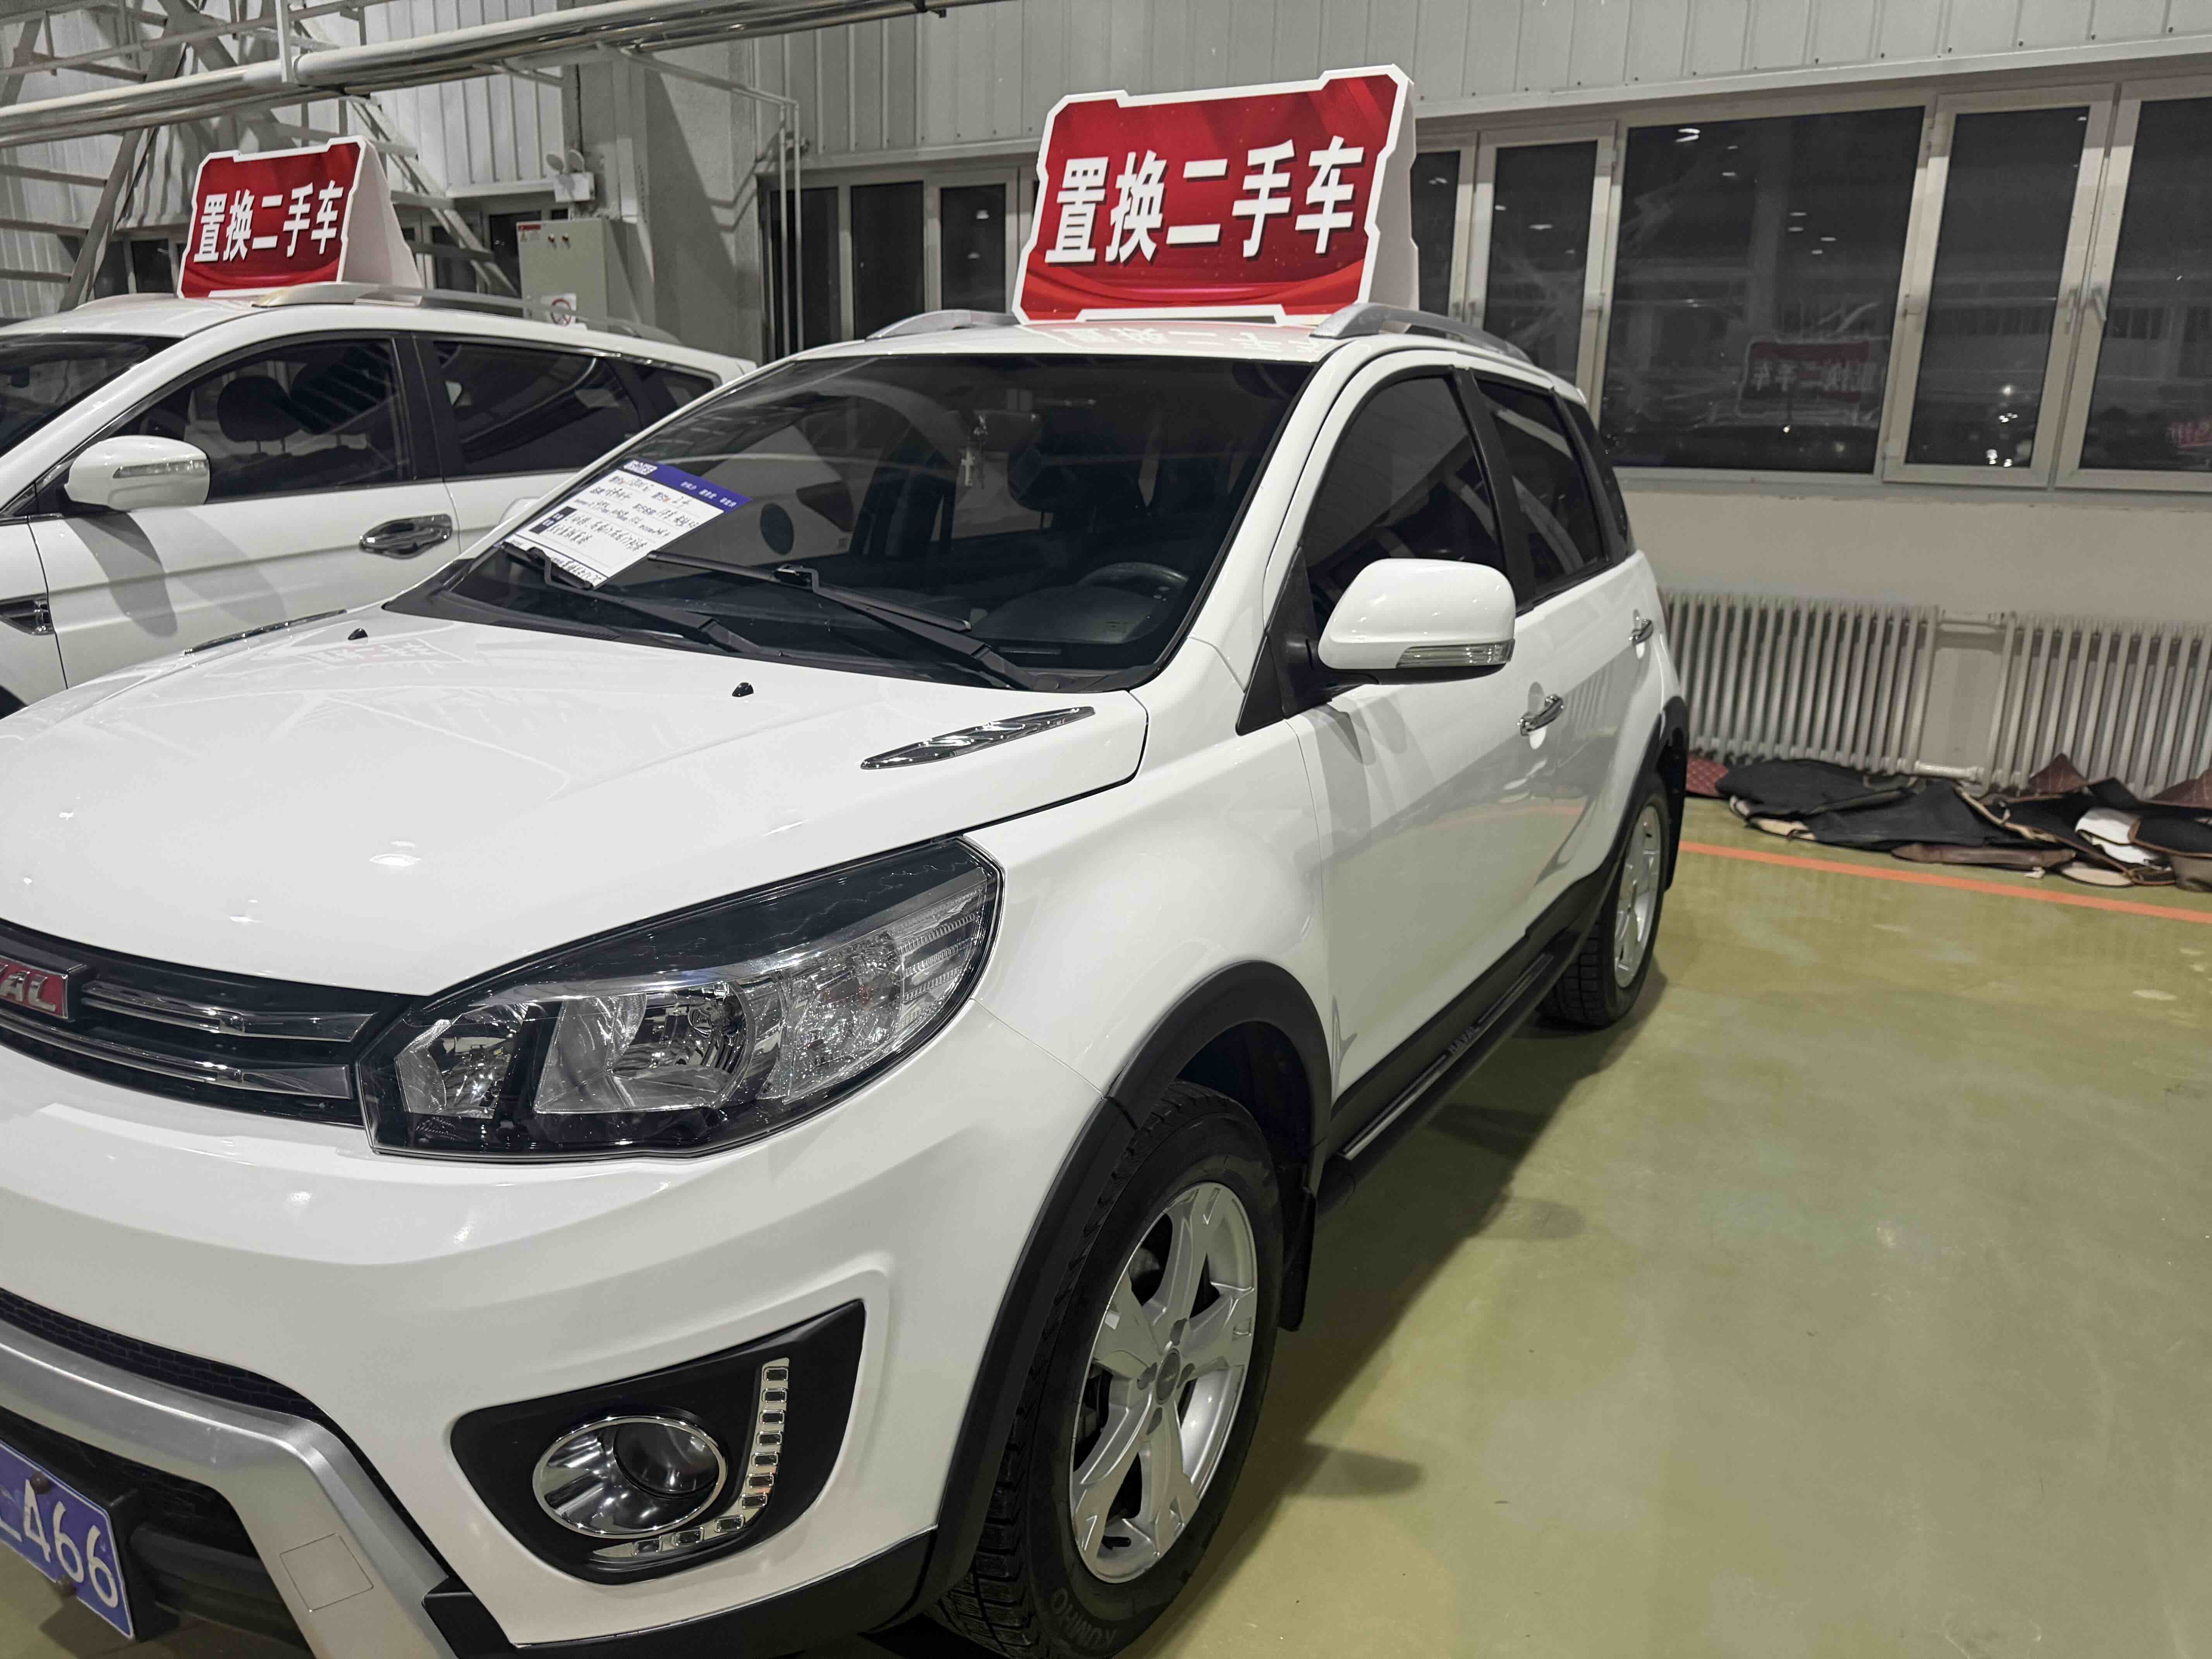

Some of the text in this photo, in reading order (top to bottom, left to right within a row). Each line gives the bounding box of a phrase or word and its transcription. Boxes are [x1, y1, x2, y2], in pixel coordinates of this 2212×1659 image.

[194, 180, 344, 263] 置换二手车
[1044, 136, 1364, 263] 置换二手车
[0, 964, 56, 1012] AL
[0, 1479, 118, 1608] 466
